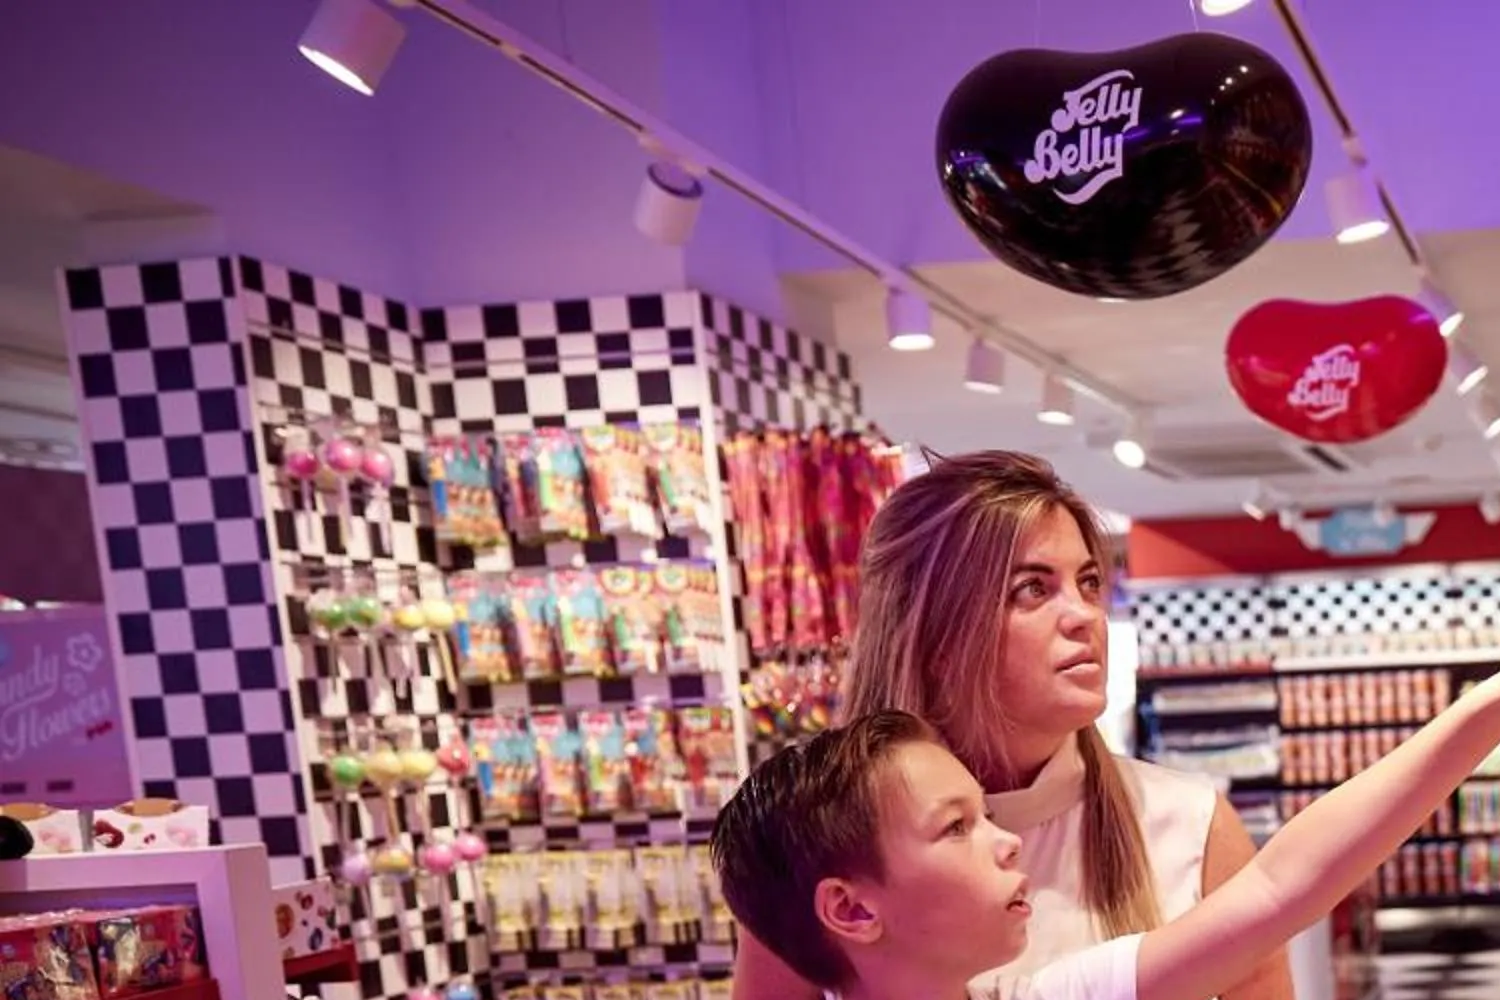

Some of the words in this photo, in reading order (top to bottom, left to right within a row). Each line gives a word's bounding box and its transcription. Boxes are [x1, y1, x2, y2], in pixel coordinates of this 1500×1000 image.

[1051, 69, 1143, 133] Jelly
[1023, 127, 1124, 205] Belly
[1303, 343, 1361, 388] Jelly
[1286, 377, 1350, 420] Belly
